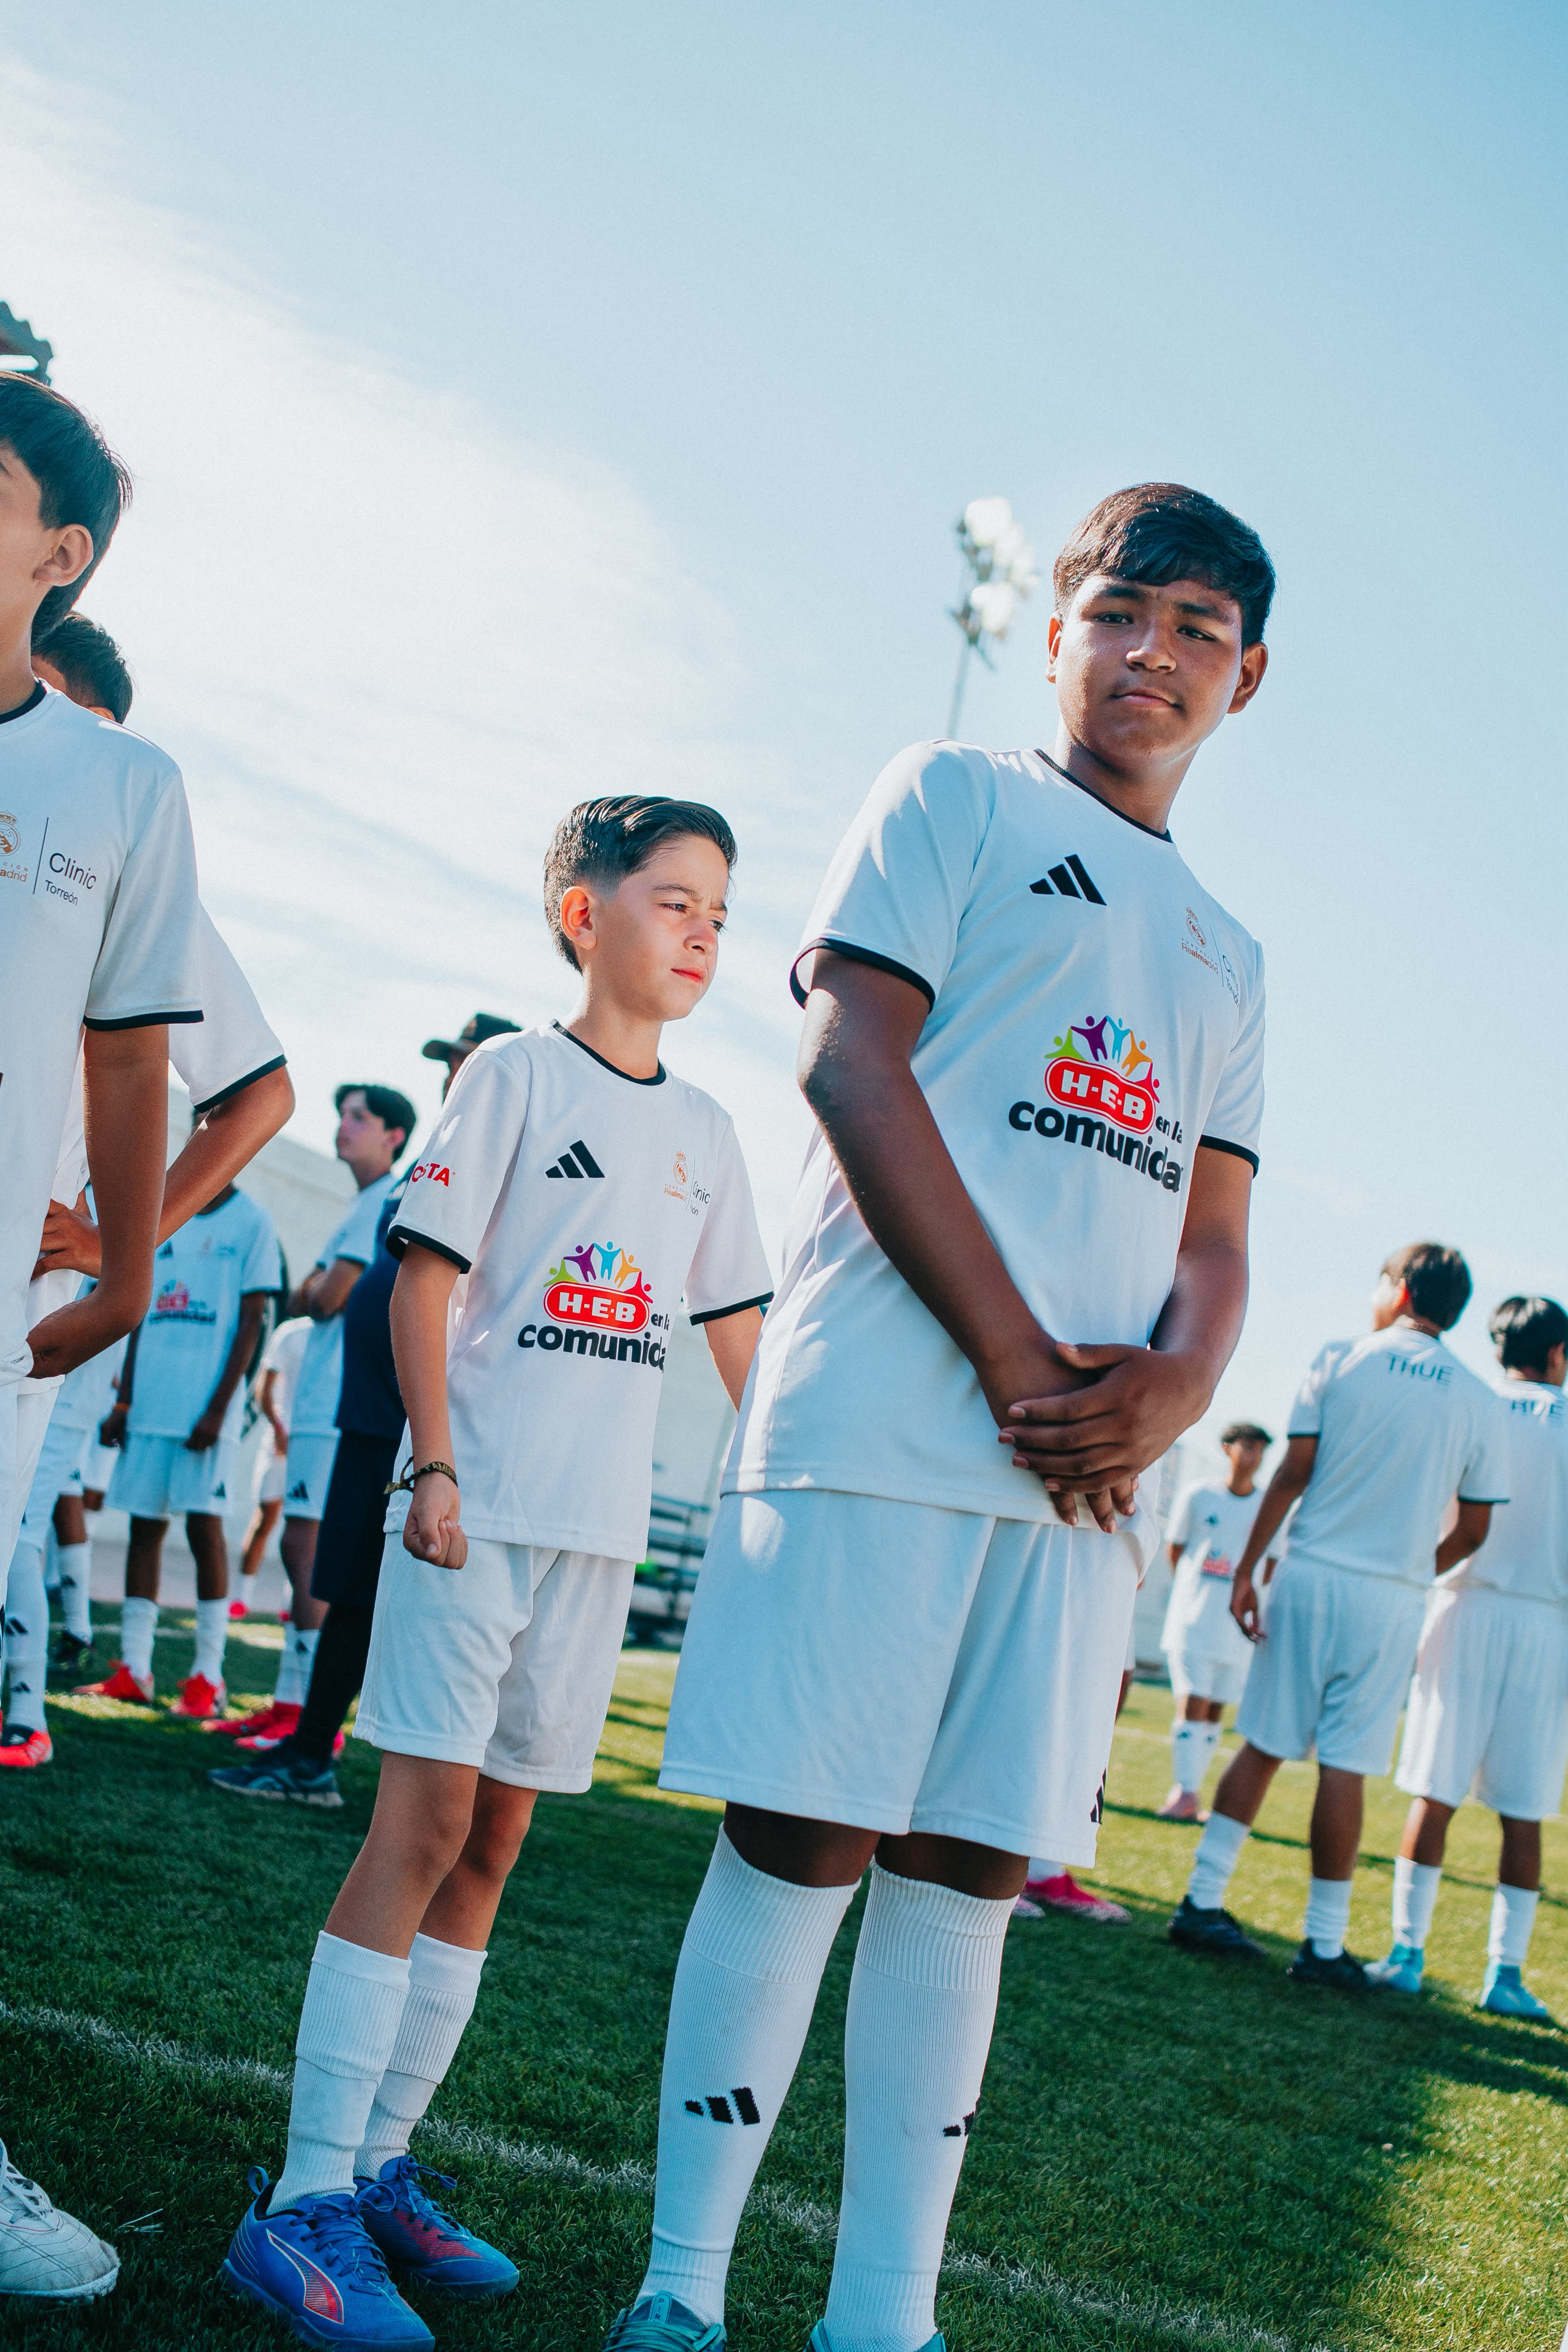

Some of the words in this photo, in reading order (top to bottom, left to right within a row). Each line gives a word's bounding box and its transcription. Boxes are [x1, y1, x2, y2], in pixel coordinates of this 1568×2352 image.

[49, 853, 97, 890] Clinic
[45, 879, 79, 906] Torreón
[1008, 1101, 1184, 1194] comunida
